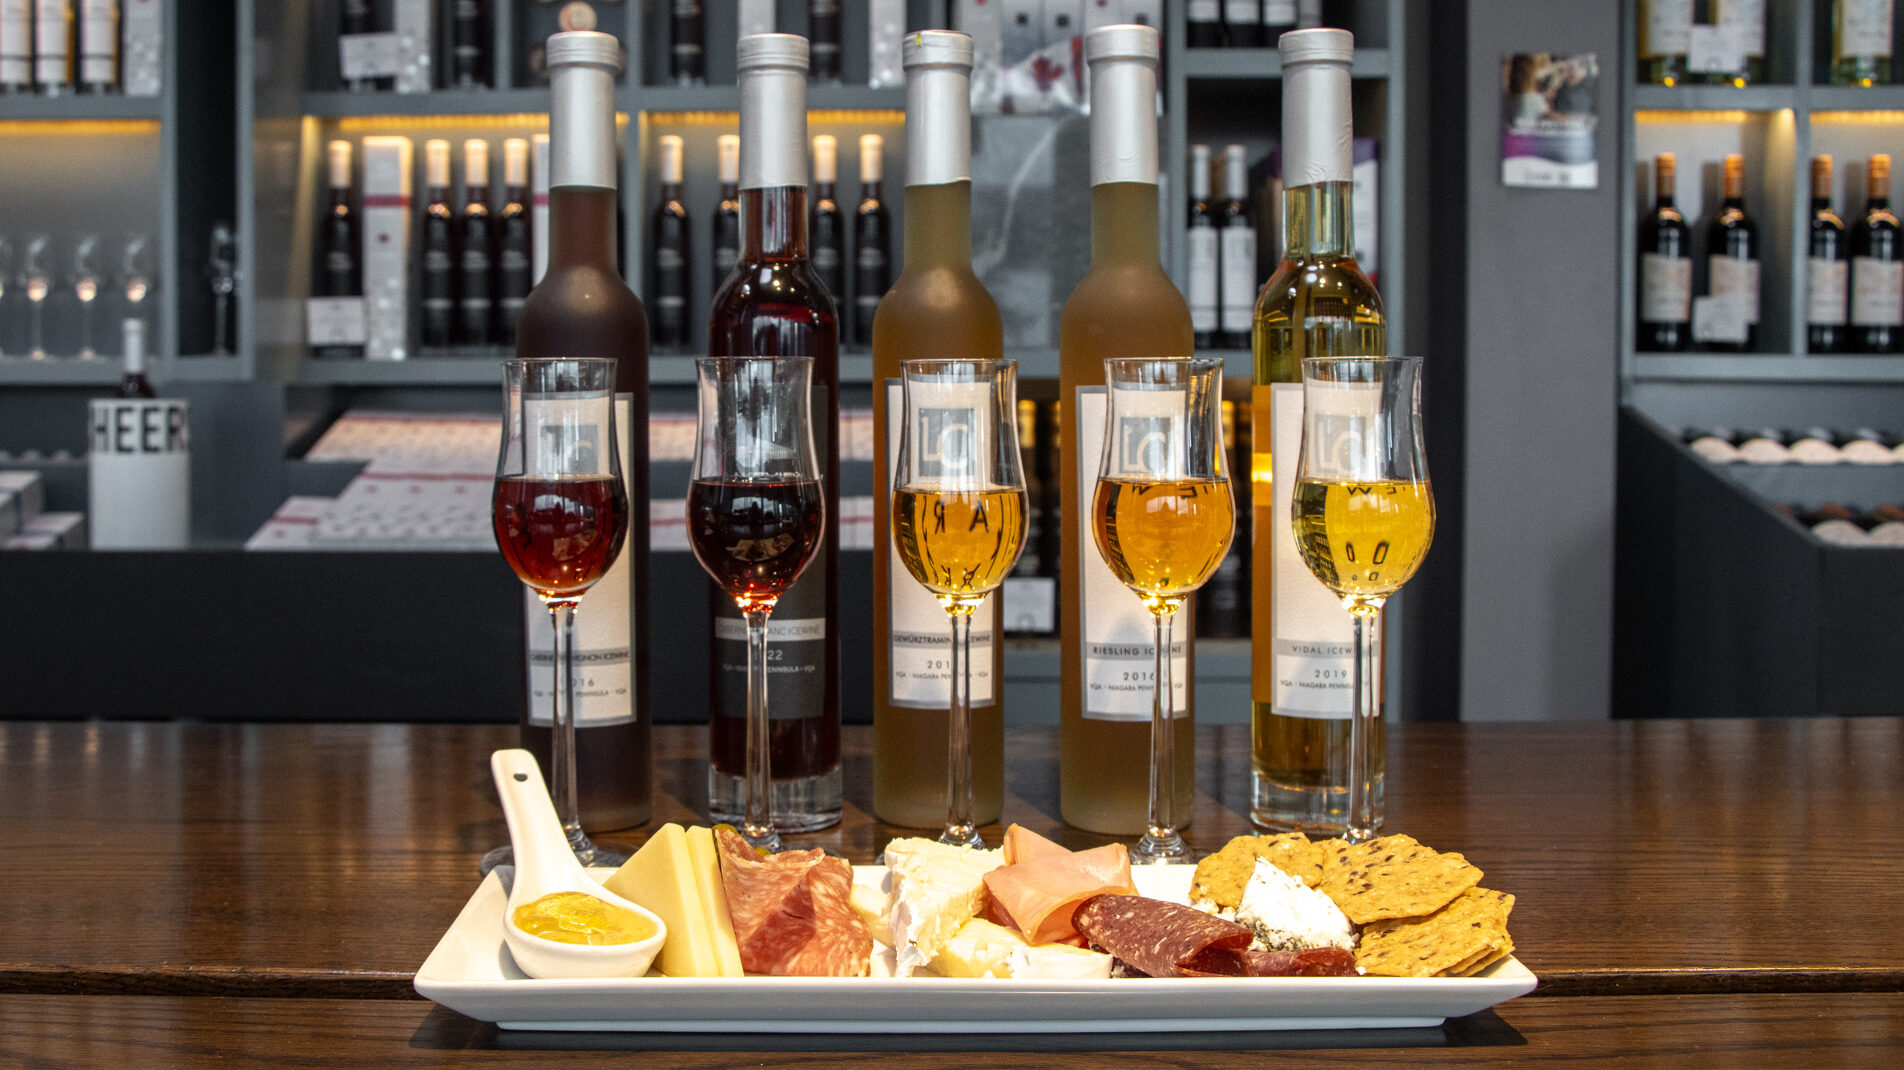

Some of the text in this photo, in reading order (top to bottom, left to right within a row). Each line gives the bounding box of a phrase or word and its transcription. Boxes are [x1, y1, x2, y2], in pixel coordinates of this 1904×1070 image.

[893, 633, 953, 645] GEWÜRZTRAMIN
[767, 649, 783, 661] 22
[1093, 645, 1182, 656] RIESLING ICNE
[1292, 645, 1354, 655] VIDAL ICEW
[927, 660, 951, 670] 201
[1314, 669, 1348, 679] 2019
[1299, 681, 1327, 690] NIAGARA
